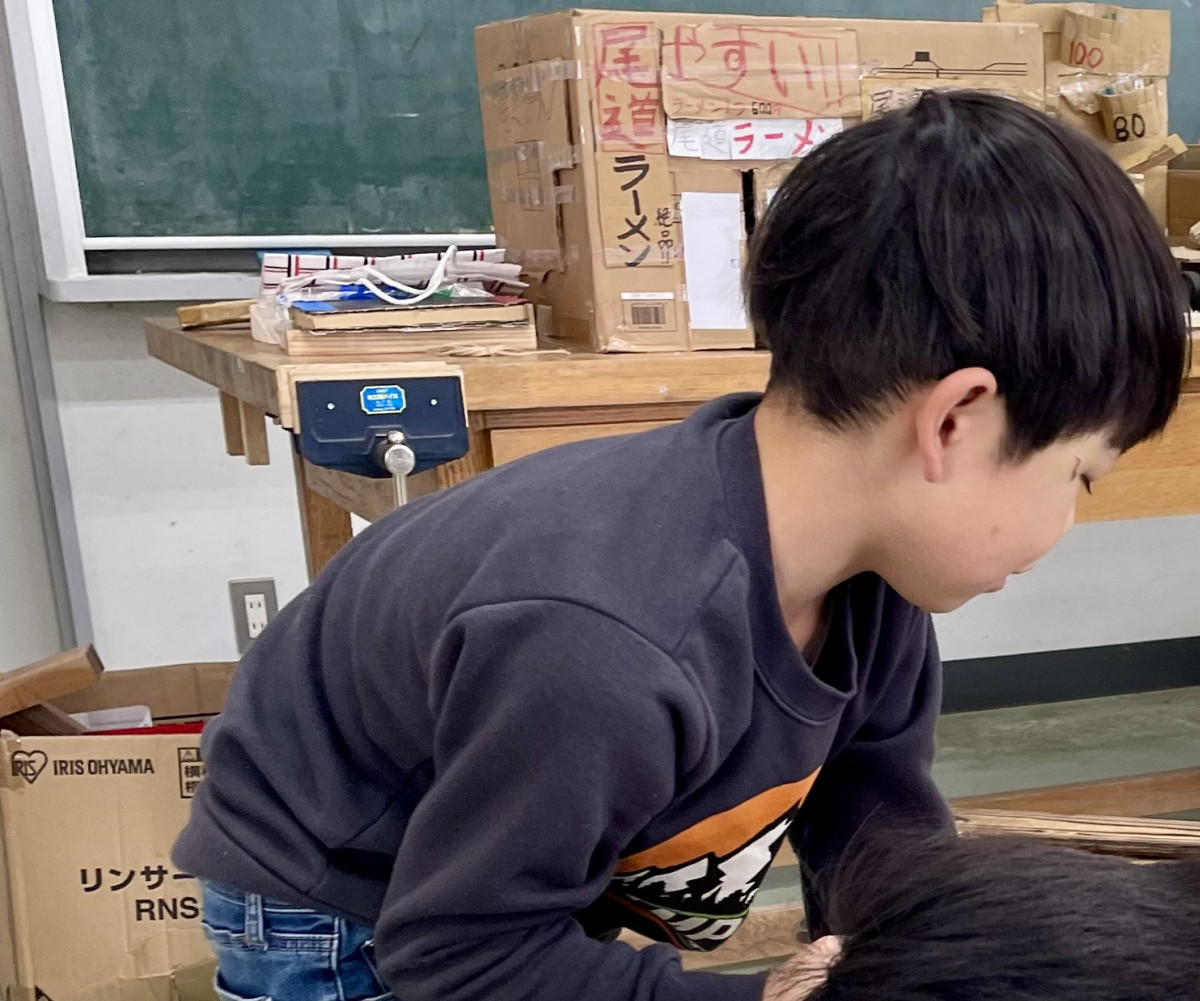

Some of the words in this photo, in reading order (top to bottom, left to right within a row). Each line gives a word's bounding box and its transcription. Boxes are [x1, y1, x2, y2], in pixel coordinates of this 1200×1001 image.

[1068, 41, 1104, 69] 100
[1112, 113, 1146, 142] 80
[54, 760, 84, 776] IRIS
[88, 759, 155, 775] OHYAMA
[135, 896, 200, 921] RNS
